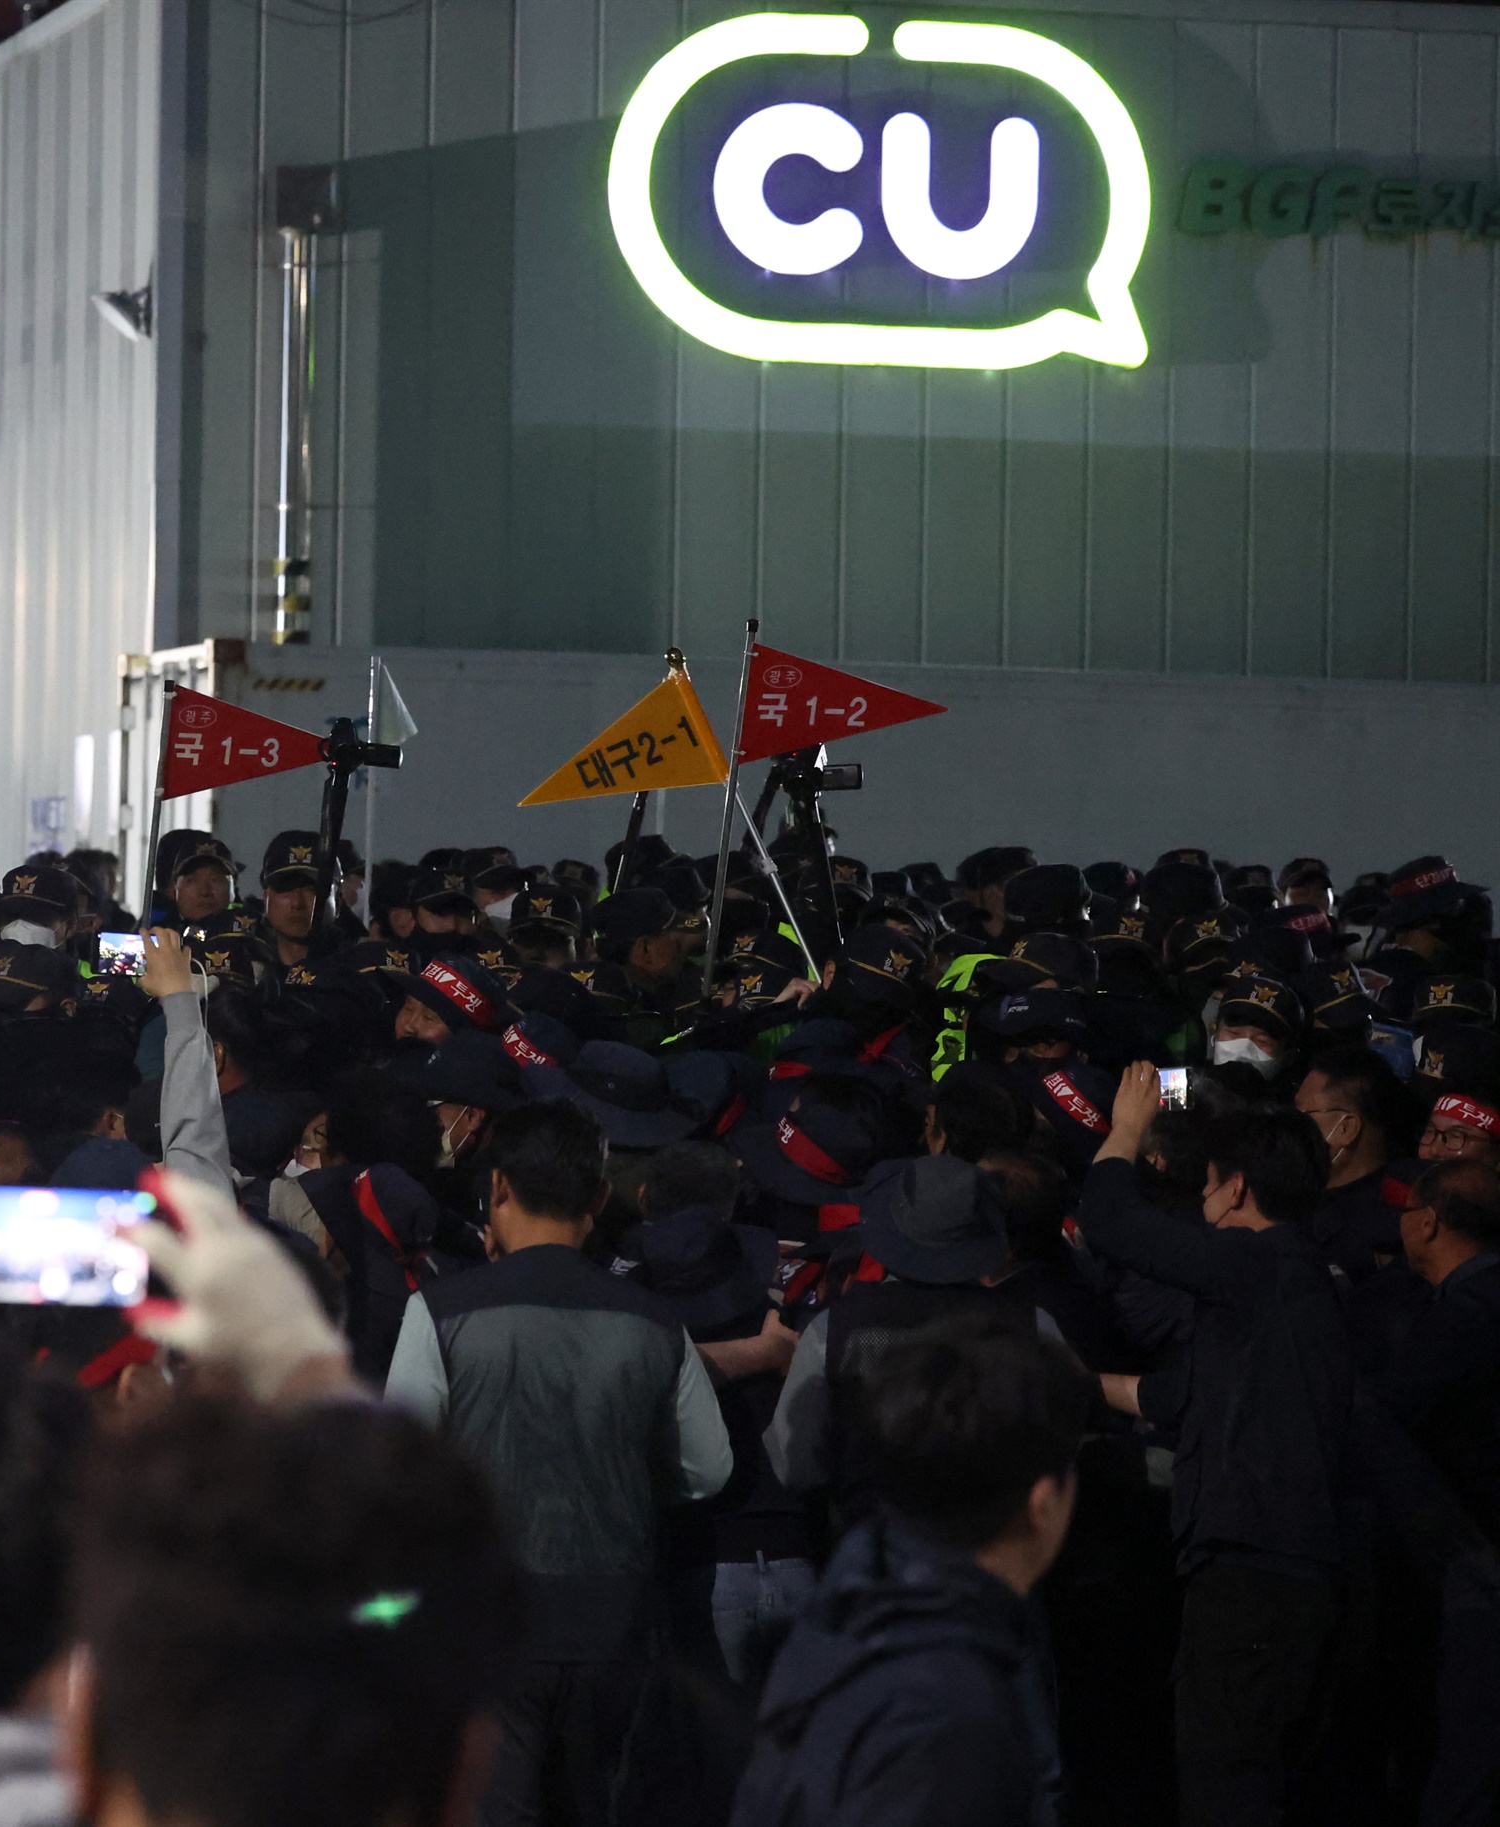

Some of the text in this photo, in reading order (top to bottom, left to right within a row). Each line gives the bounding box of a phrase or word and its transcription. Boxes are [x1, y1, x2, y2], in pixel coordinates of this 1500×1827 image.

[713, 102, 1040, 280] CU
[768, 669, 797, 683] 광주
[185, 709, 212, 723] 광주
[757, 693, 868, 727] 국 1-2
[174, 732, 280, 768] 국 1-3
[450, 980, 483, 1013] 투쟁
[1067, 1095, 1100, 1128] 투쟁
